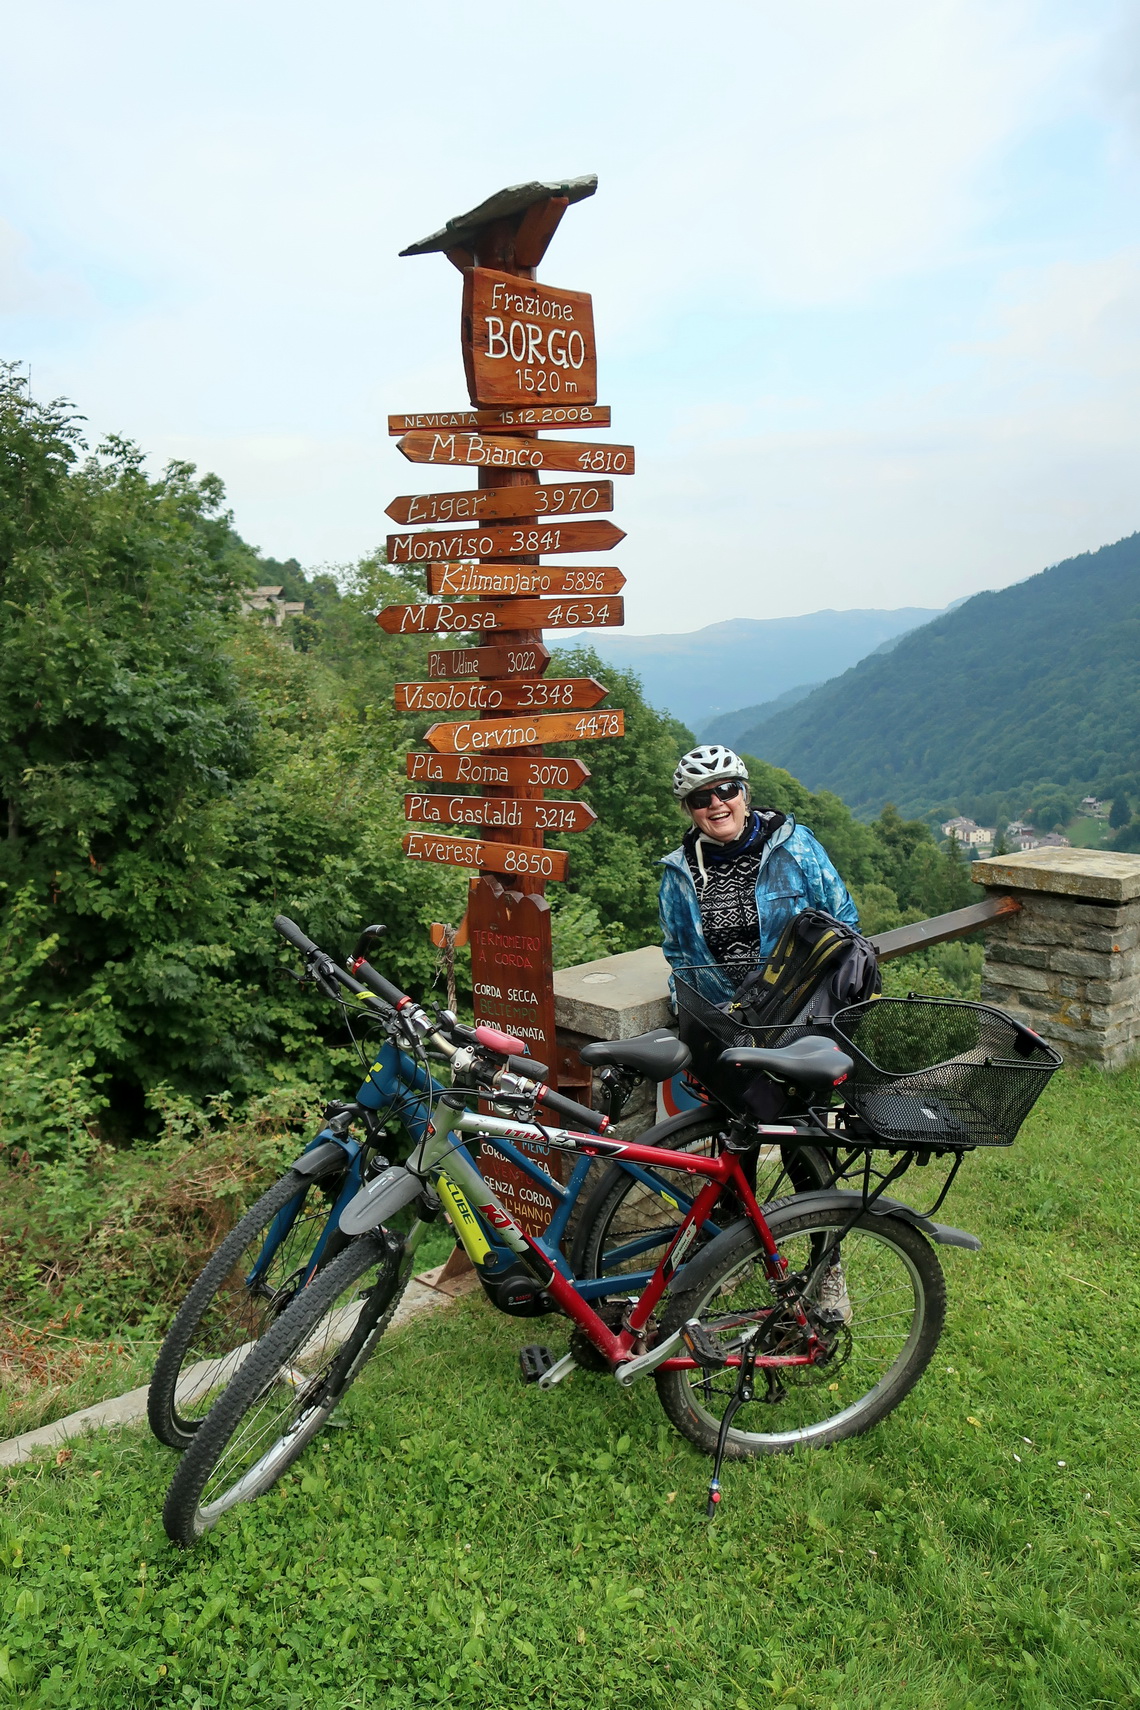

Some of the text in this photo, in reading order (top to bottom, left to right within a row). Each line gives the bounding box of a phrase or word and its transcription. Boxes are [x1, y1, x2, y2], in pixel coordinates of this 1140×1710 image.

[491, 283, 574, 321] Frazione
[485, 316, 585, 369] BORGO
[515, 369, 577, 392] 1520 m
[405, 407, 592, 427] NEVICATA 15.12.2008
[466, 436, 543, 466] Bianco
[578, 451, 627, 471] 4810
[406, 488, 599, 522] Eiger 3970
[392, 530, 561, 562] Monviso 3841
[438, 564, 604, 595] Kilimanjaro 5896
[435, 605, 497, 630] Rosa
[547, 604, 609, 625] 4634
[452, 648, 479, 674] Udine
[507, 652, 536, 672] 3022
[403, 684, 574, 709] Visolotto 3348
[453, 714, 619, 751] Cervino 4478
[456, 756, 509, 782] Roma
[528, 764, 569, 785] 3070
[449, 798, 522, 826] Gastaldi
[535, 806, 576, 829] 3214
[406, 834, 553, 875] Everest 8850
[473, 929, 541, 951] TERMOMETRO
[478, 950, 533, 968] A CORDA
[474, 982, 538, 1005] CORDA SECCA
[506, 1024, 546, 1041] BAGNATA
[446, 1181, 474, 1224] CUBE
[483, 1175, 552, 1209] SENZA CORDA
[477, 1202, 530, 1253] KTM
[505, 1198, 552, 1226] L'HANNO
